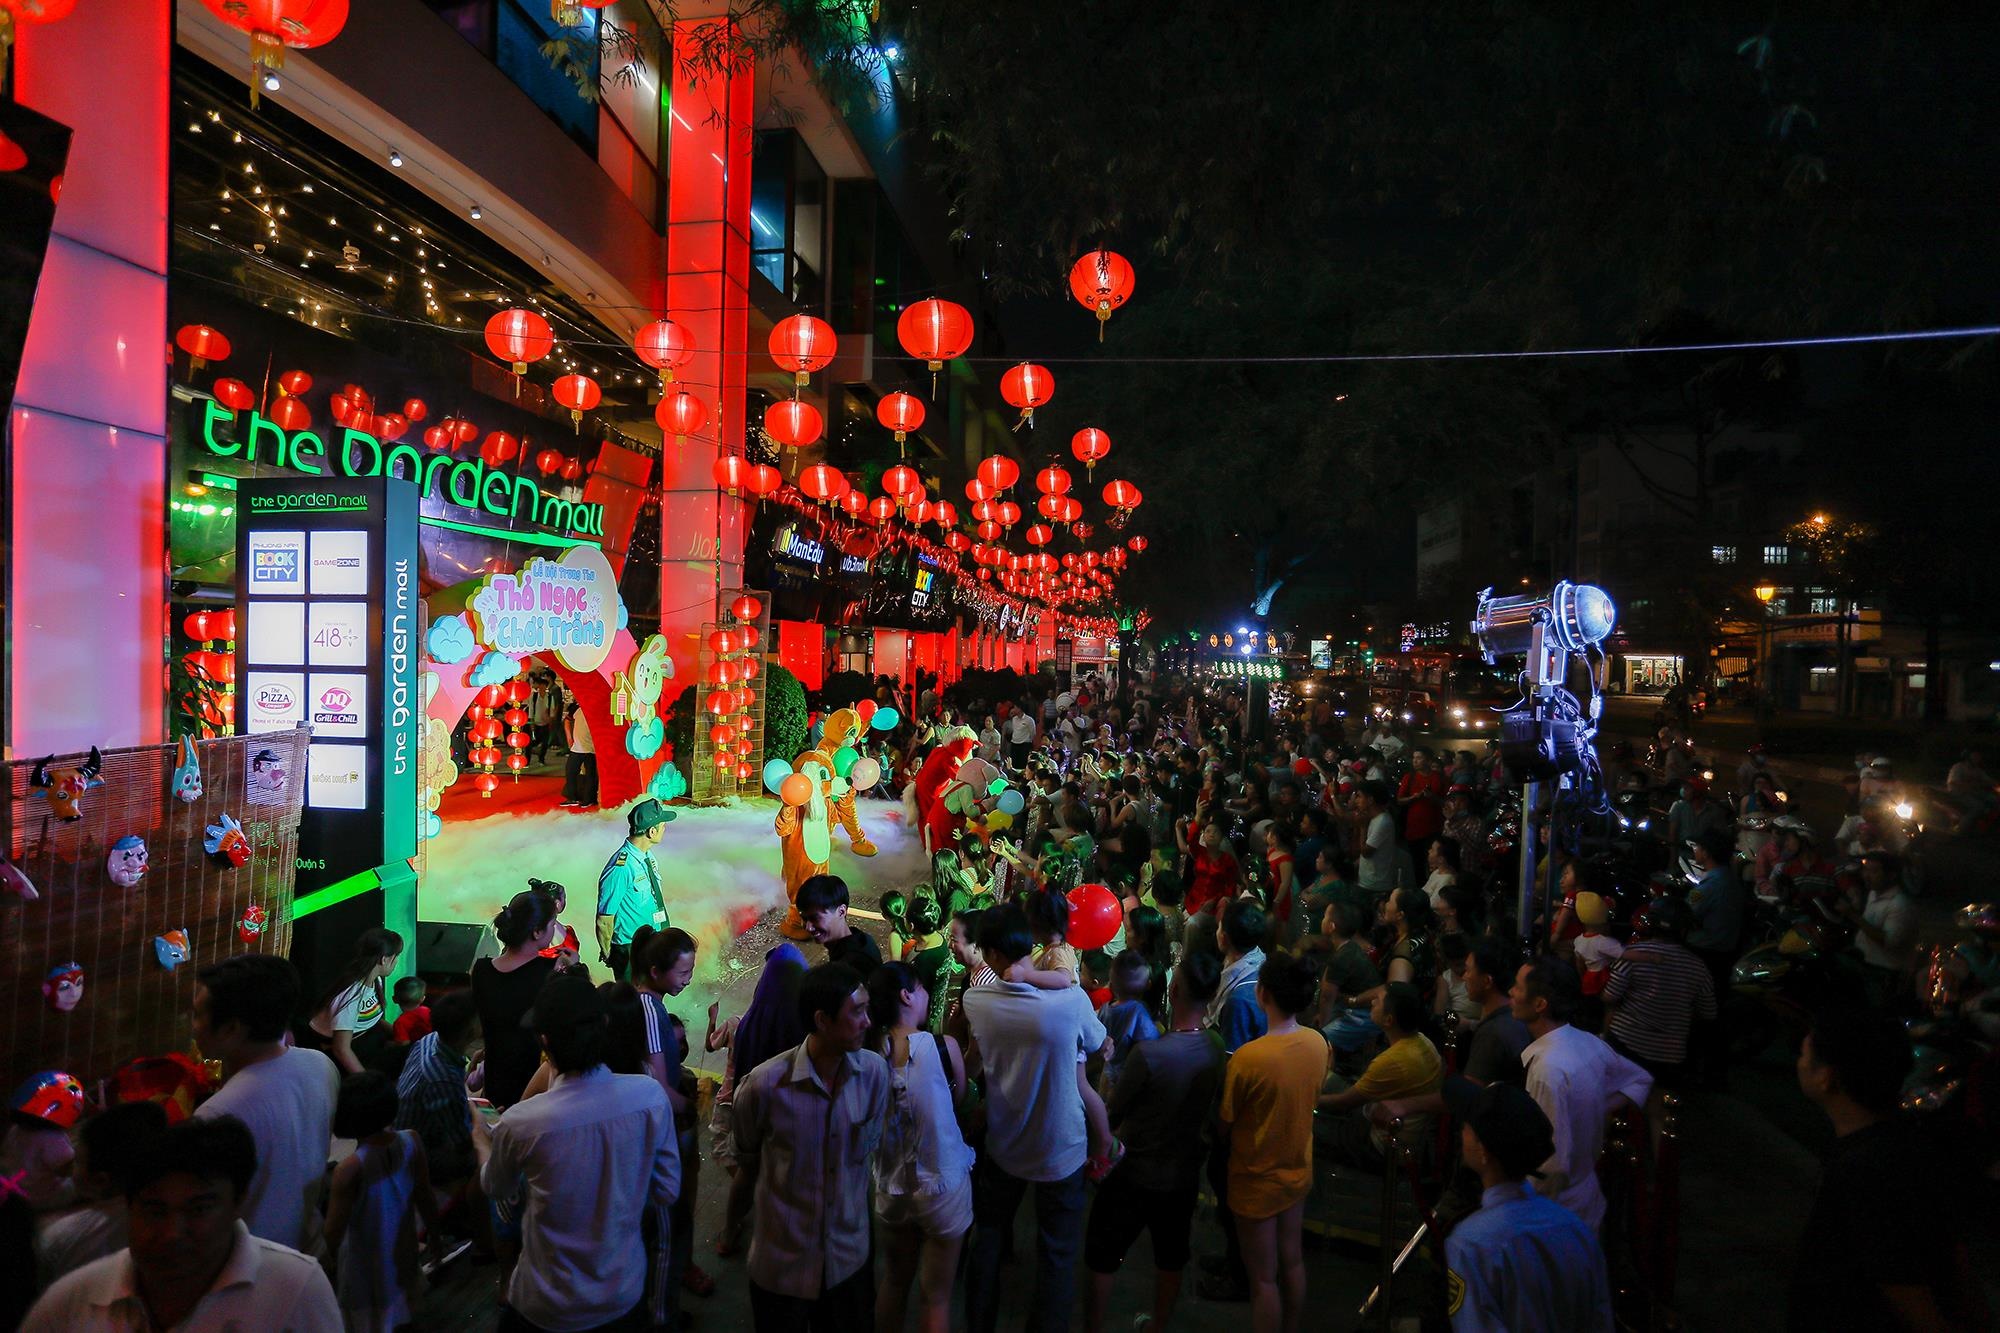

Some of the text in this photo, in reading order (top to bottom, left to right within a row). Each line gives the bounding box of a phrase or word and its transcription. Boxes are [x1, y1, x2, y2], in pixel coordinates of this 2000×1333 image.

[203, 399, 605, 537] the garden mall
[251, 492, 368, 510] the garden mall
[786, 533, 825, 564] ManEdu
[256, 552, 295, 567] BOOK
[313, 558, 360, 568] GAMEZONE
[256, 567, 295, 579] CITY
[493, 574, 588, 618] Thỏ Ngọc
[911, 590, 930, 608] CITY
[496, 611, 605, 649] Chơi Trăng
[391, 558, 410, 775] the garden mall
[260, 691, 290, 703] PIZZA
[325, 692, 349, 708] DQ
[295, 857, 326, 871] Quận 5
